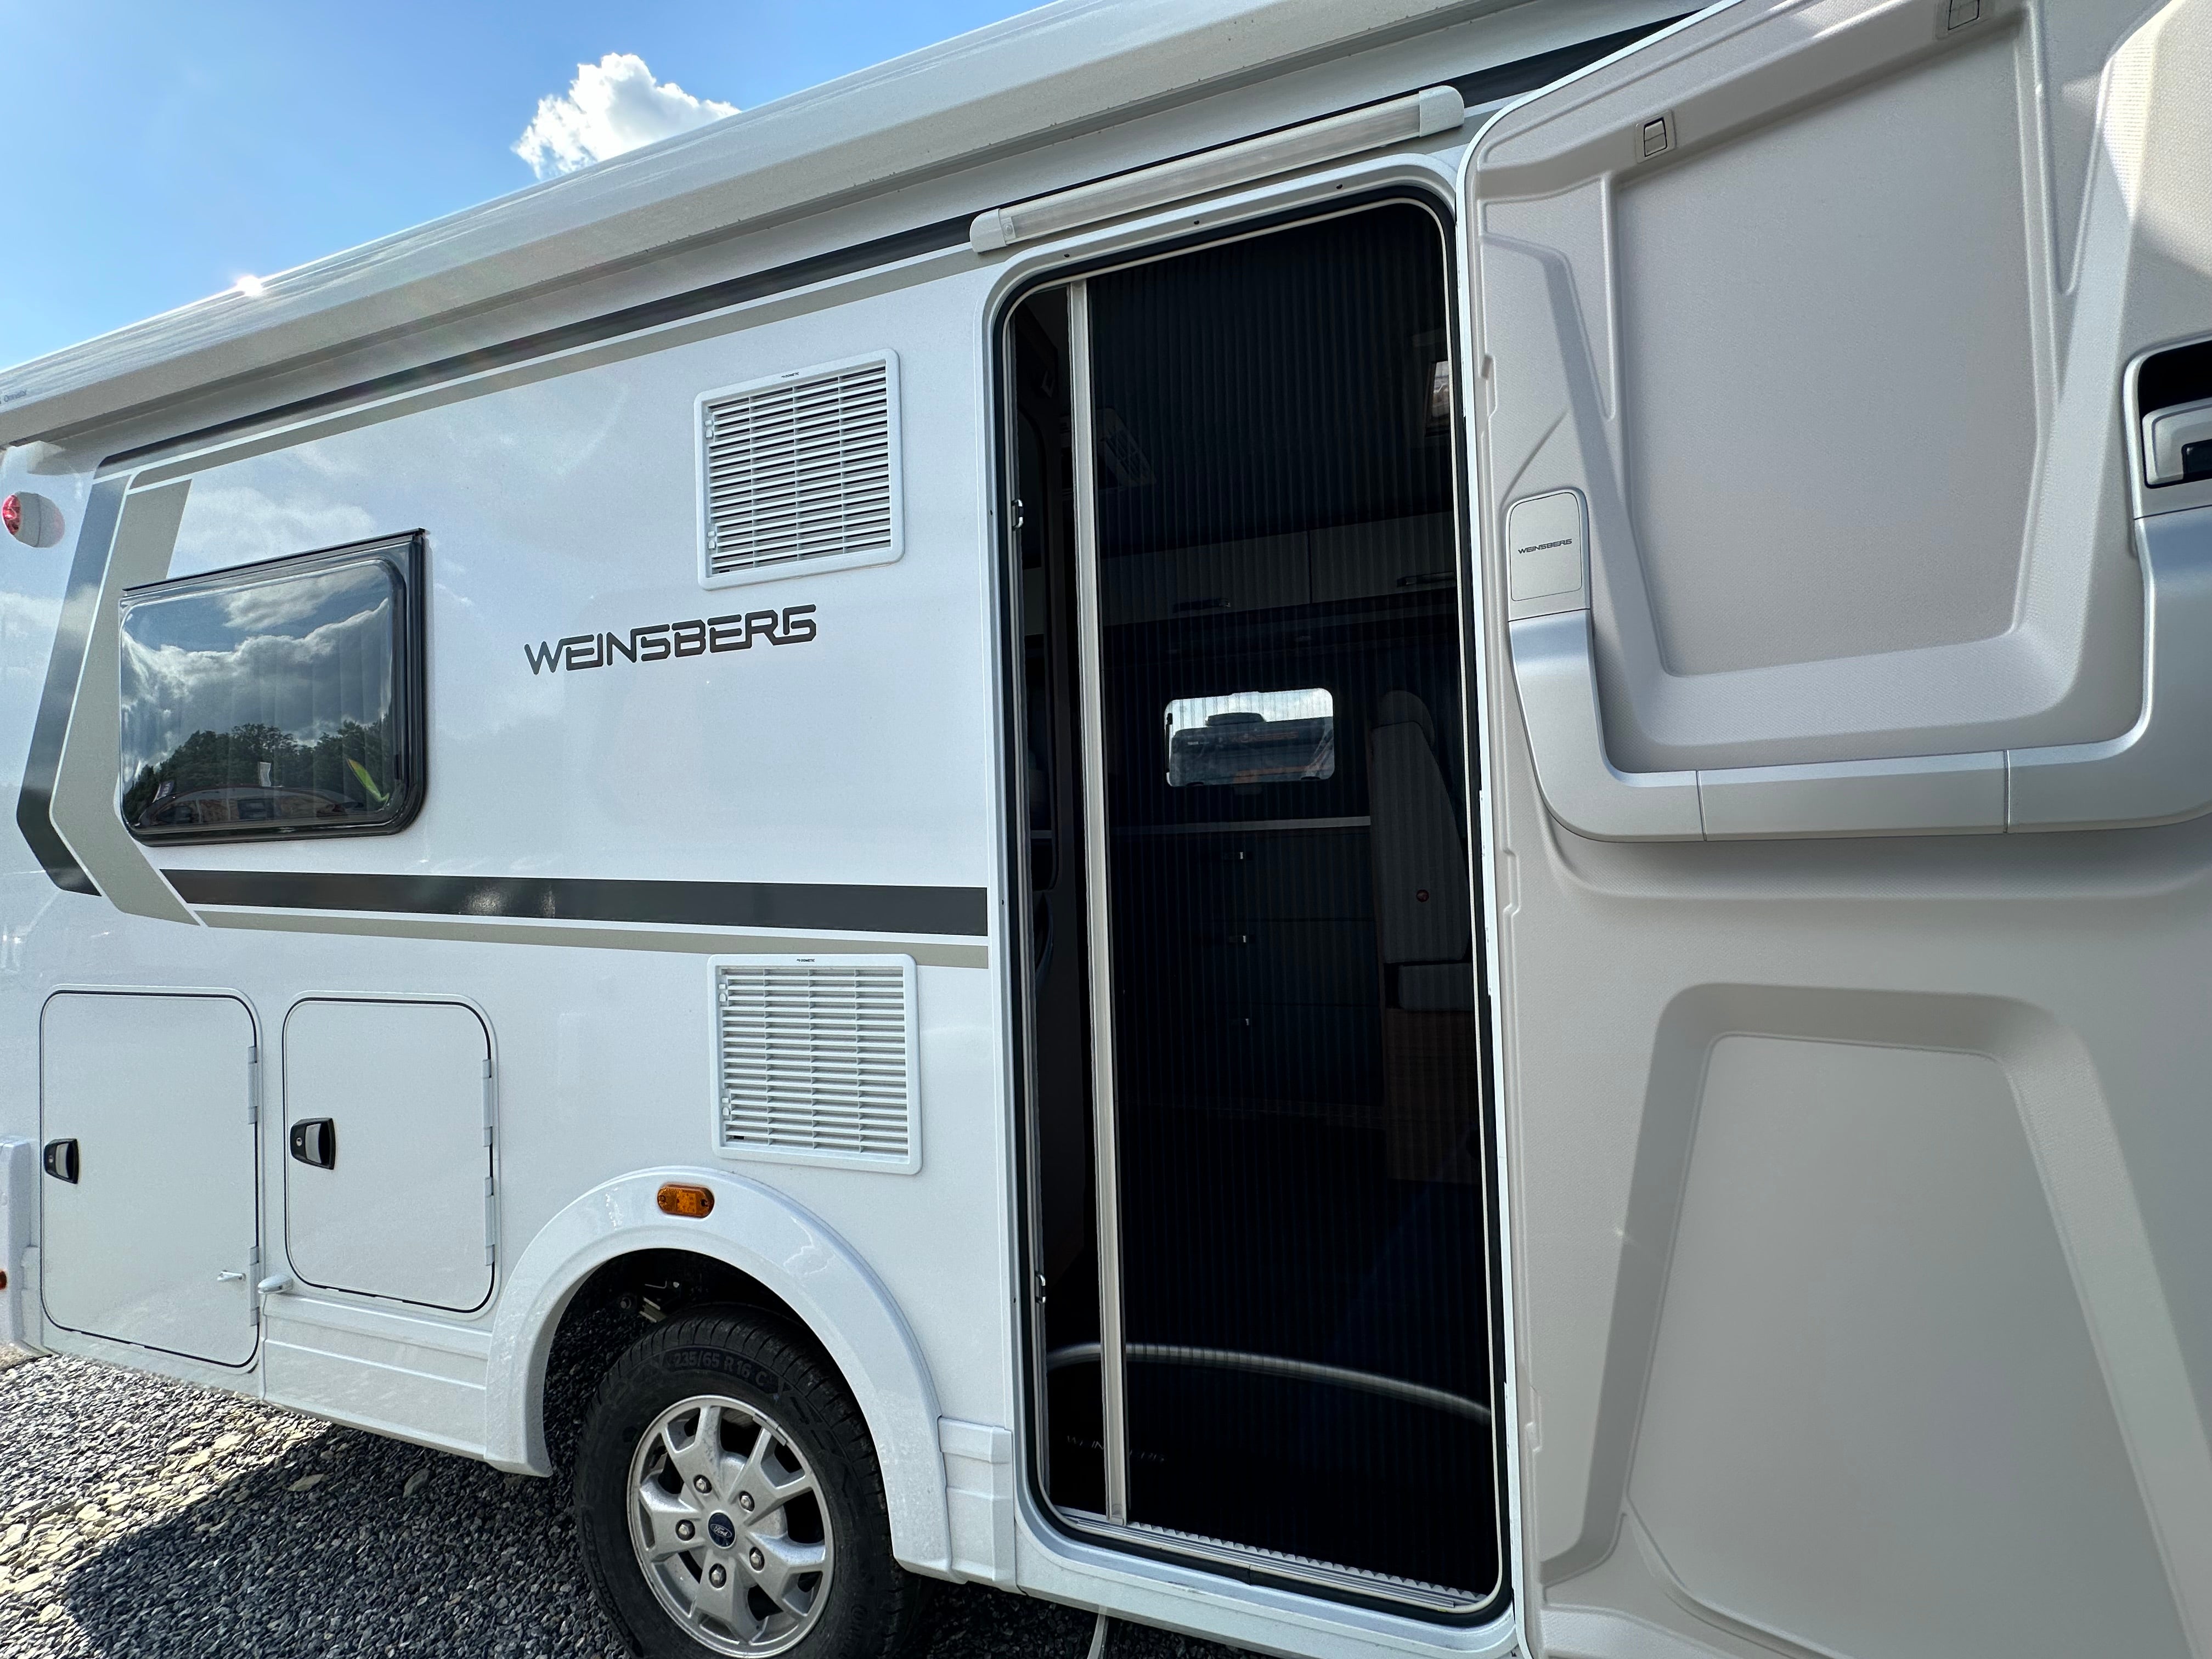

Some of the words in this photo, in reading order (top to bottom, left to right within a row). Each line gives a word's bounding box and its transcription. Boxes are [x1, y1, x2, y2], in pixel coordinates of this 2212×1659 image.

[1517, 538, 1572, 554] WEINSBERG
[524, 604, 816, 675] WEINSBERG
[674, 1351, 720, 1367] 235/65
[724, 1355, 735, 1371] R
[736, 1360, 752, 1379] 16
[755, 1371, 768, 1386] C
[714, 1525, 729, 1537] Ford
